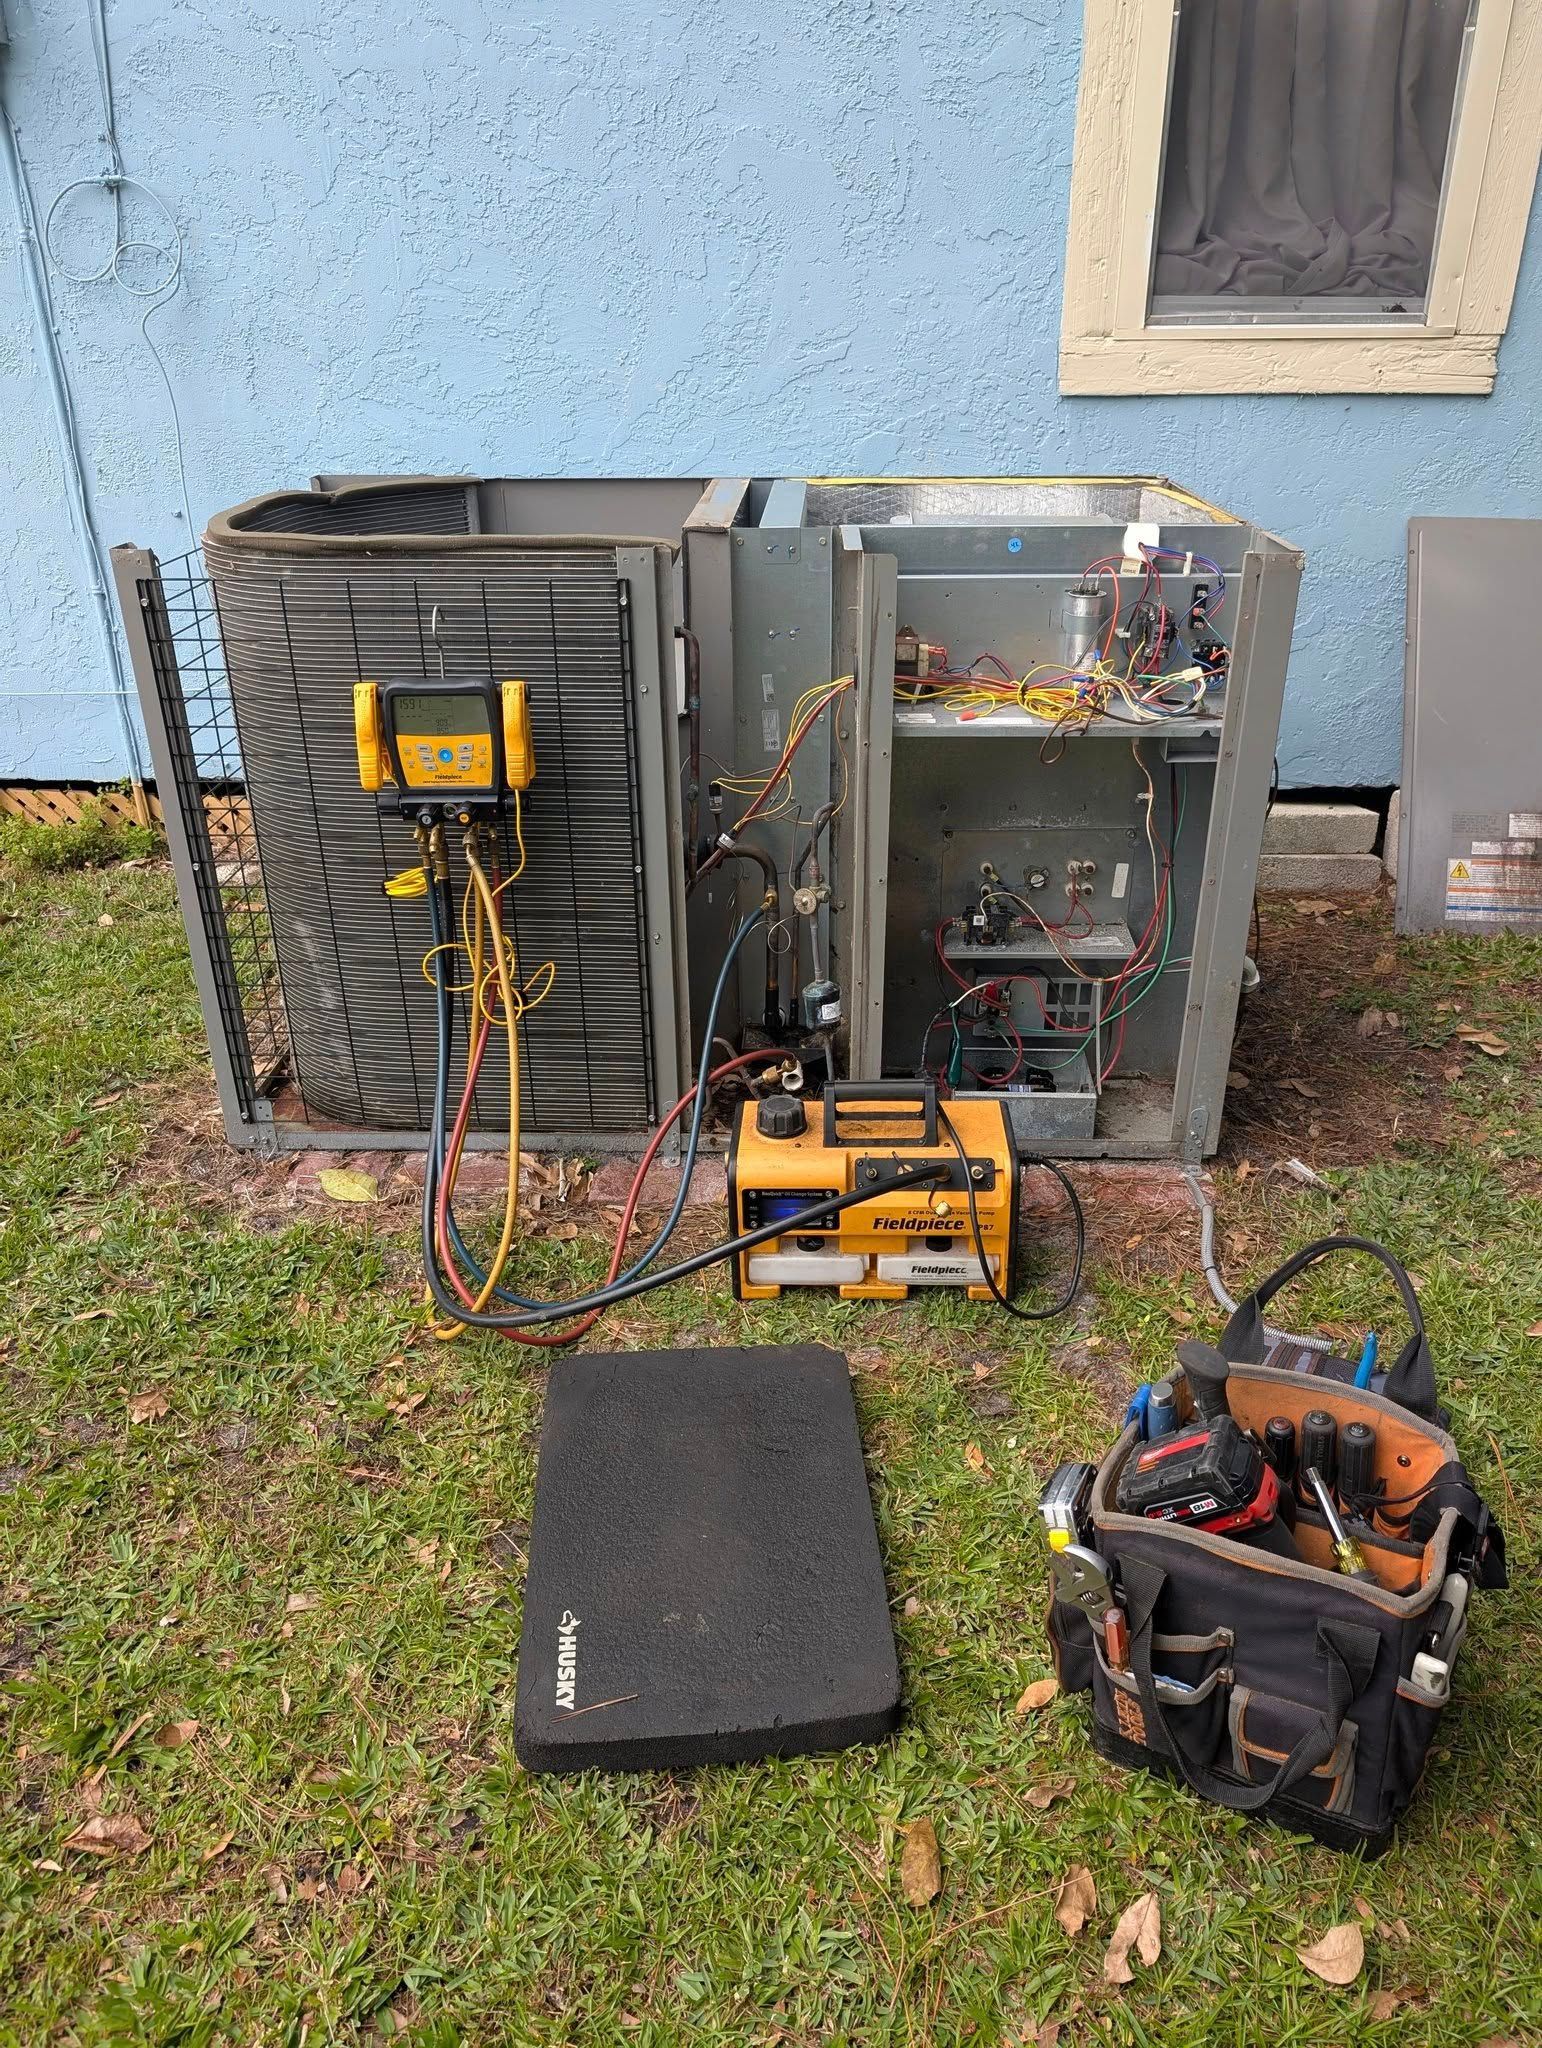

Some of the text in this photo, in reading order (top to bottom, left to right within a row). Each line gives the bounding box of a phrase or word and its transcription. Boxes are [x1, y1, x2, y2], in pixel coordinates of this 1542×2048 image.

[872, 1217, 965, 1232] Fieldpiece
[1193, 1500, 1216, 1512] M18
[556, 1636, 577, 1710] HUSKY
